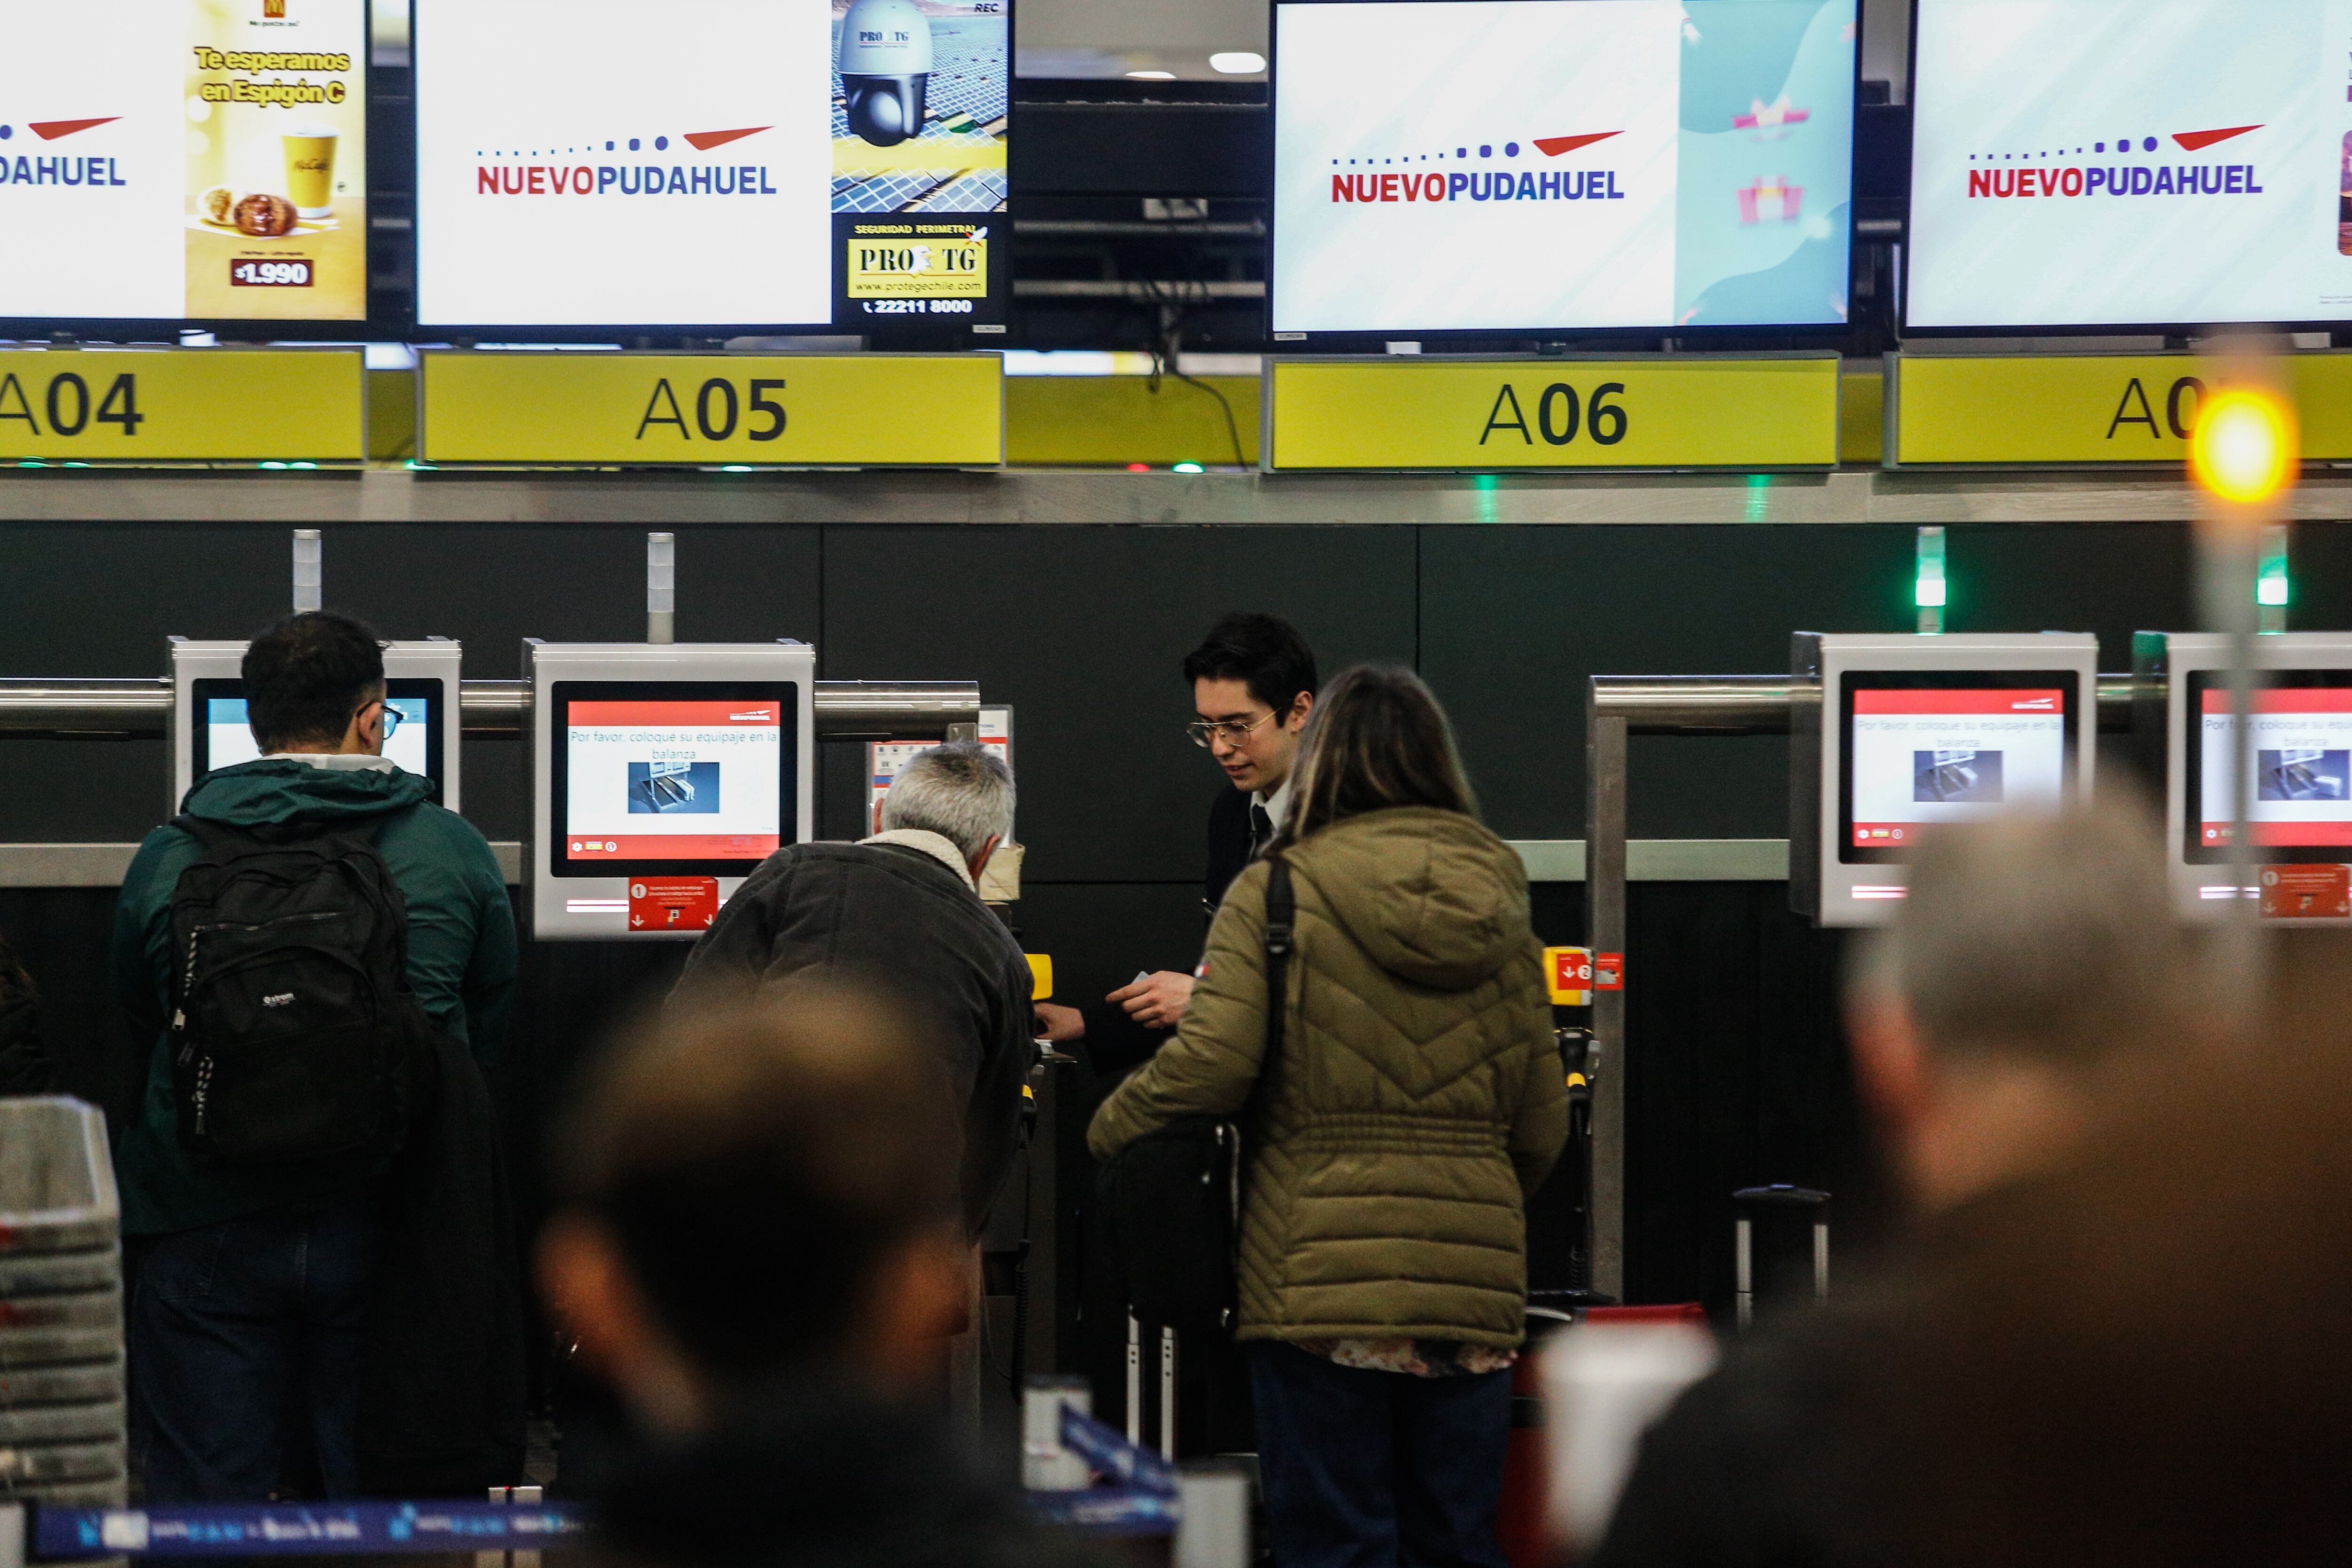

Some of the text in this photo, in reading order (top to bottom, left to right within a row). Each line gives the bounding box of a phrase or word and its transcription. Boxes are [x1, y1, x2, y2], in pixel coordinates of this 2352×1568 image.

[975, 3, 999, 13] REC
[859, 31, 909, 41] PRO TG
[193, 47, 351, 75] Te esperamos
[200, 78, 346, 109] en Espigón C
[478, 166, 777, 195] NUEVOPUDAHUEL
[1332, 171, 1624, 203] NUEVOPUDAHUEL
[1968, 165, 2263, 198] NUEVOPUDAHUEL
[854, 224, 913, 234] SEGURIDAD
[860, 248, 976, 271] PRO TG
[234, 262, 309, 285] $1.990
[856, 281, 981, 293] www.protegechile.com
[874, 299, 974, 314] 22211 8000
[0, 372, 144, 437] A04
[635, 378, 787, 441] A05
[1478, 382, 1628, 446] A06
[2106, 375, 2225, 440] A0
[571, 732, 590, 742] Por
[594, 731, 626, 743] favor,
[629, 732, 676, 744] coloque
[696, 731, 746, 745] equipaje
[767, 732, 777, 742] la
[652, 748, 696, 759] balanza
